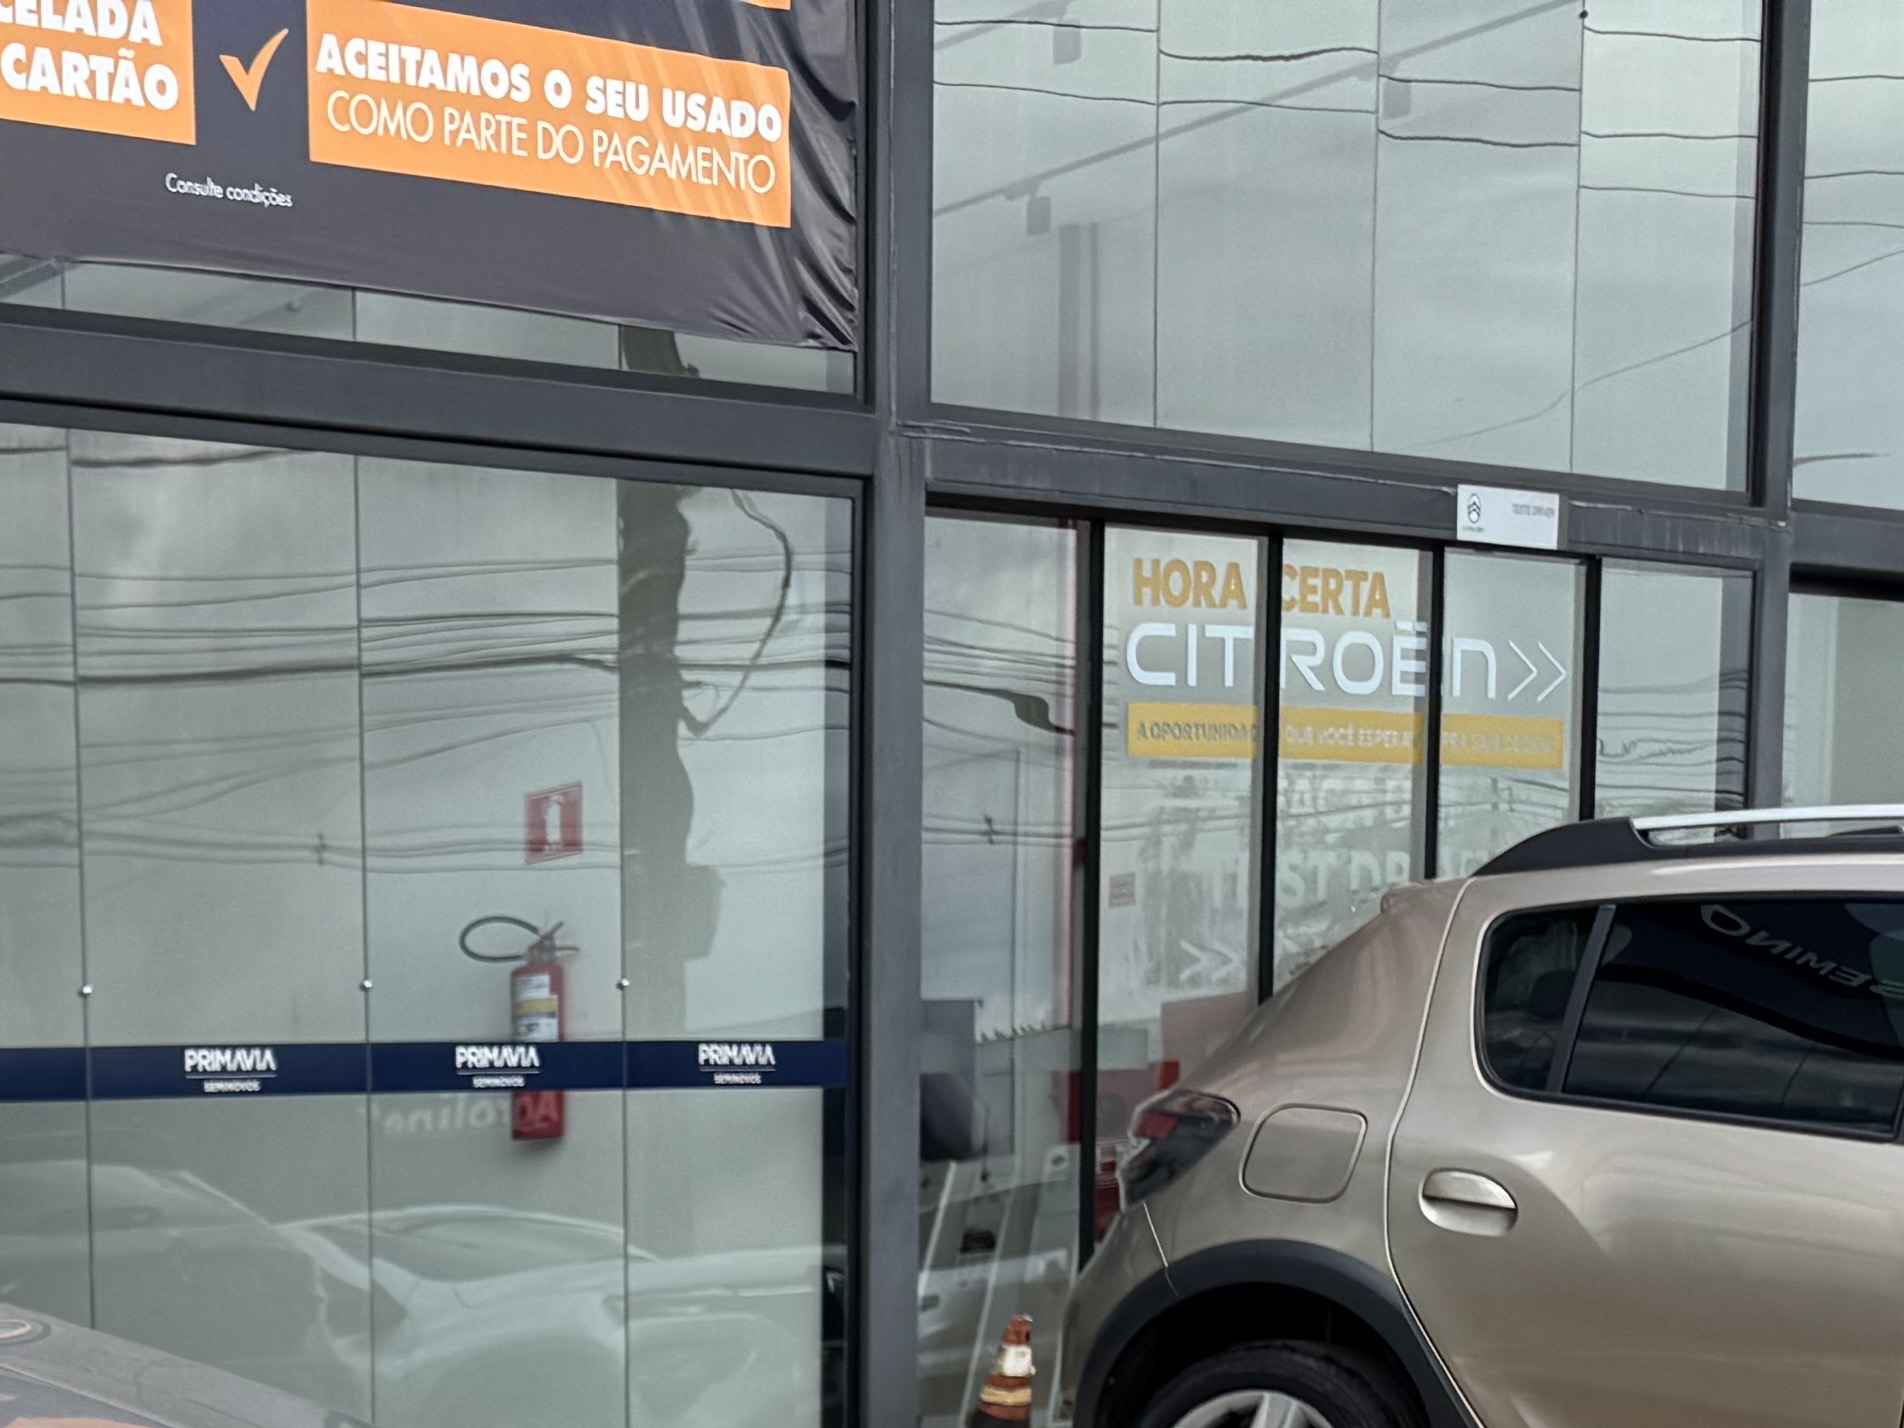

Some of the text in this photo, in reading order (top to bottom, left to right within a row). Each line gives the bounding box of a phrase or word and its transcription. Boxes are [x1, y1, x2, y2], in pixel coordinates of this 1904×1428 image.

[0, 42, 180, 111] CARTÃO
[315, 33, 783, 143] ACEITAMOS O SEU USADO
[325, 89, 776, 195] COMO PARTE DO PAGAMENTO
[165, 172, 293, 208] Consulte condições
[1133, 557, 1392, 619] HORA CERTA
[184, 1048, 277, 1073] PRIMAVIA
[455, 1045, 540, 1069] PRIMAVIA
[698, 1043, 776, 1067] PRIMAVIA
